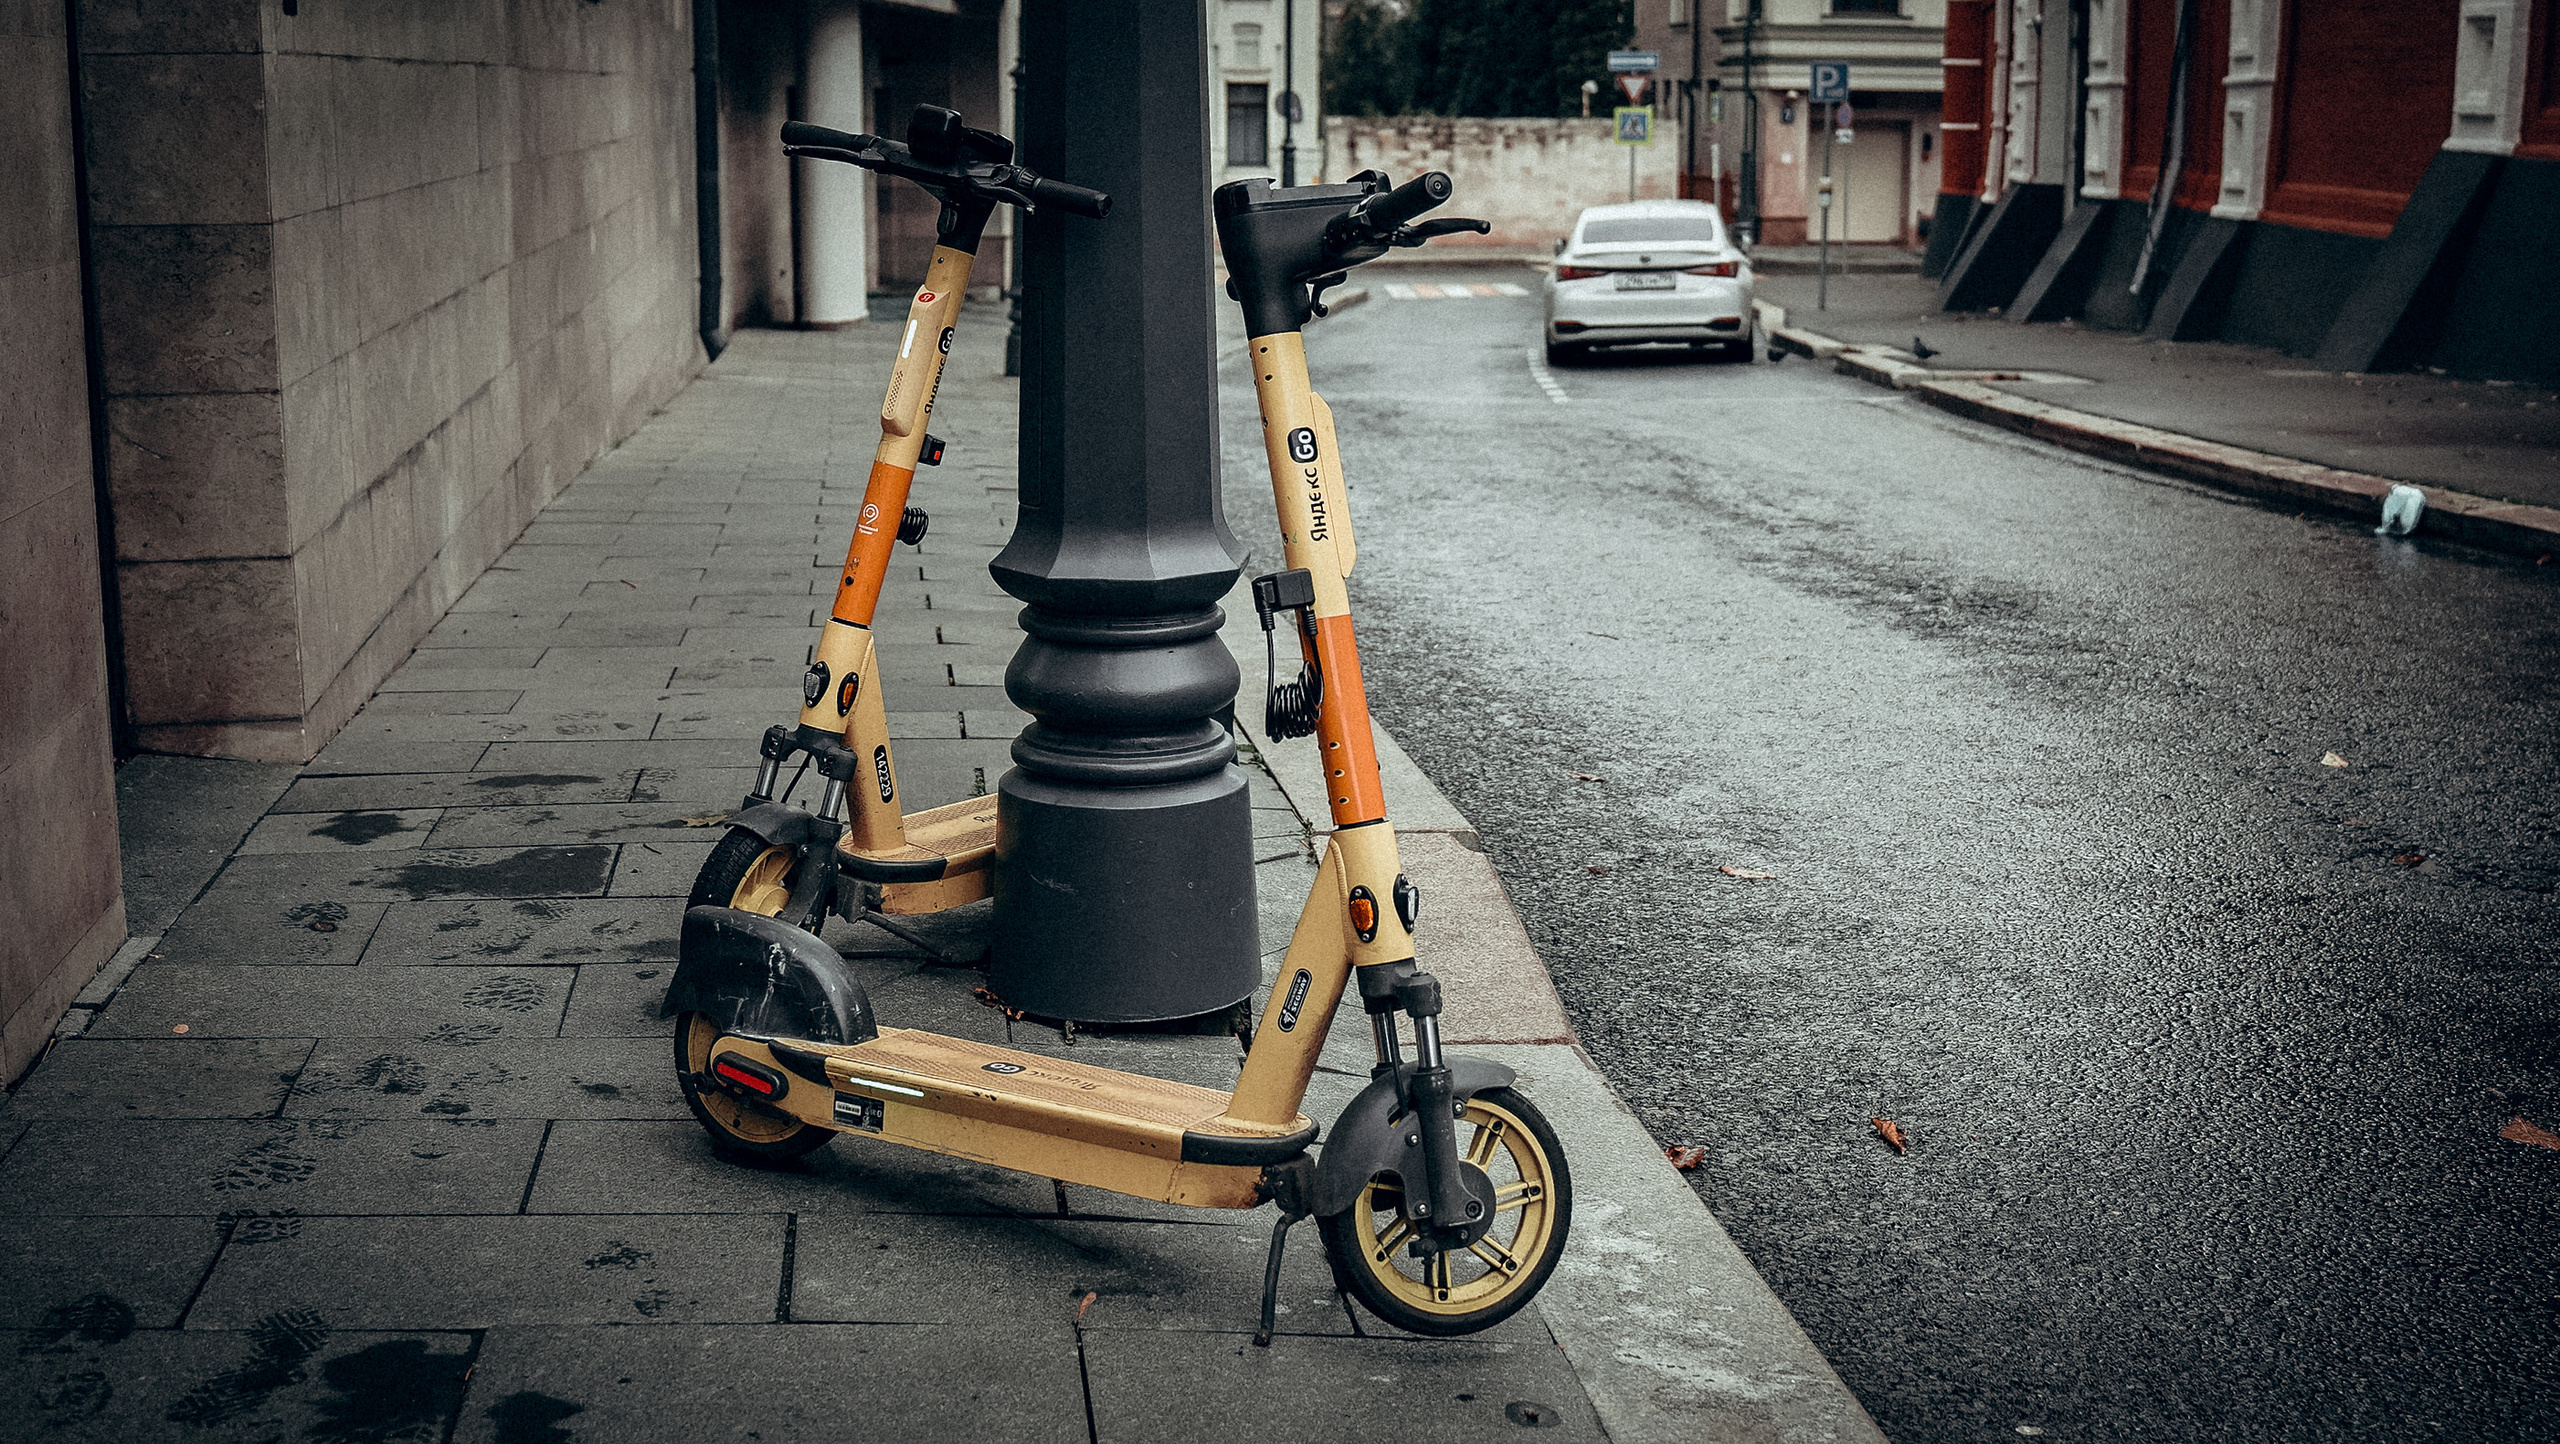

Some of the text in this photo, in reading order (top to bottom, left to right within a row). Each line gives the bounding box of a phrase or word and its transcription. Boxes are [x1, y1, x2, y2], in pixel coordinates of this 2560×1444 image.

[1816, 66, 1839, 97] P
[924, 330, 954, 415] Яндекс Go
[1295, 430, 1329, 542] Яндекс Go
[876, 752, 893, 797] 142229
[1291, 976, 1307, 1013] SEGWAY
[989, 1062, 1020, 1073] Go
